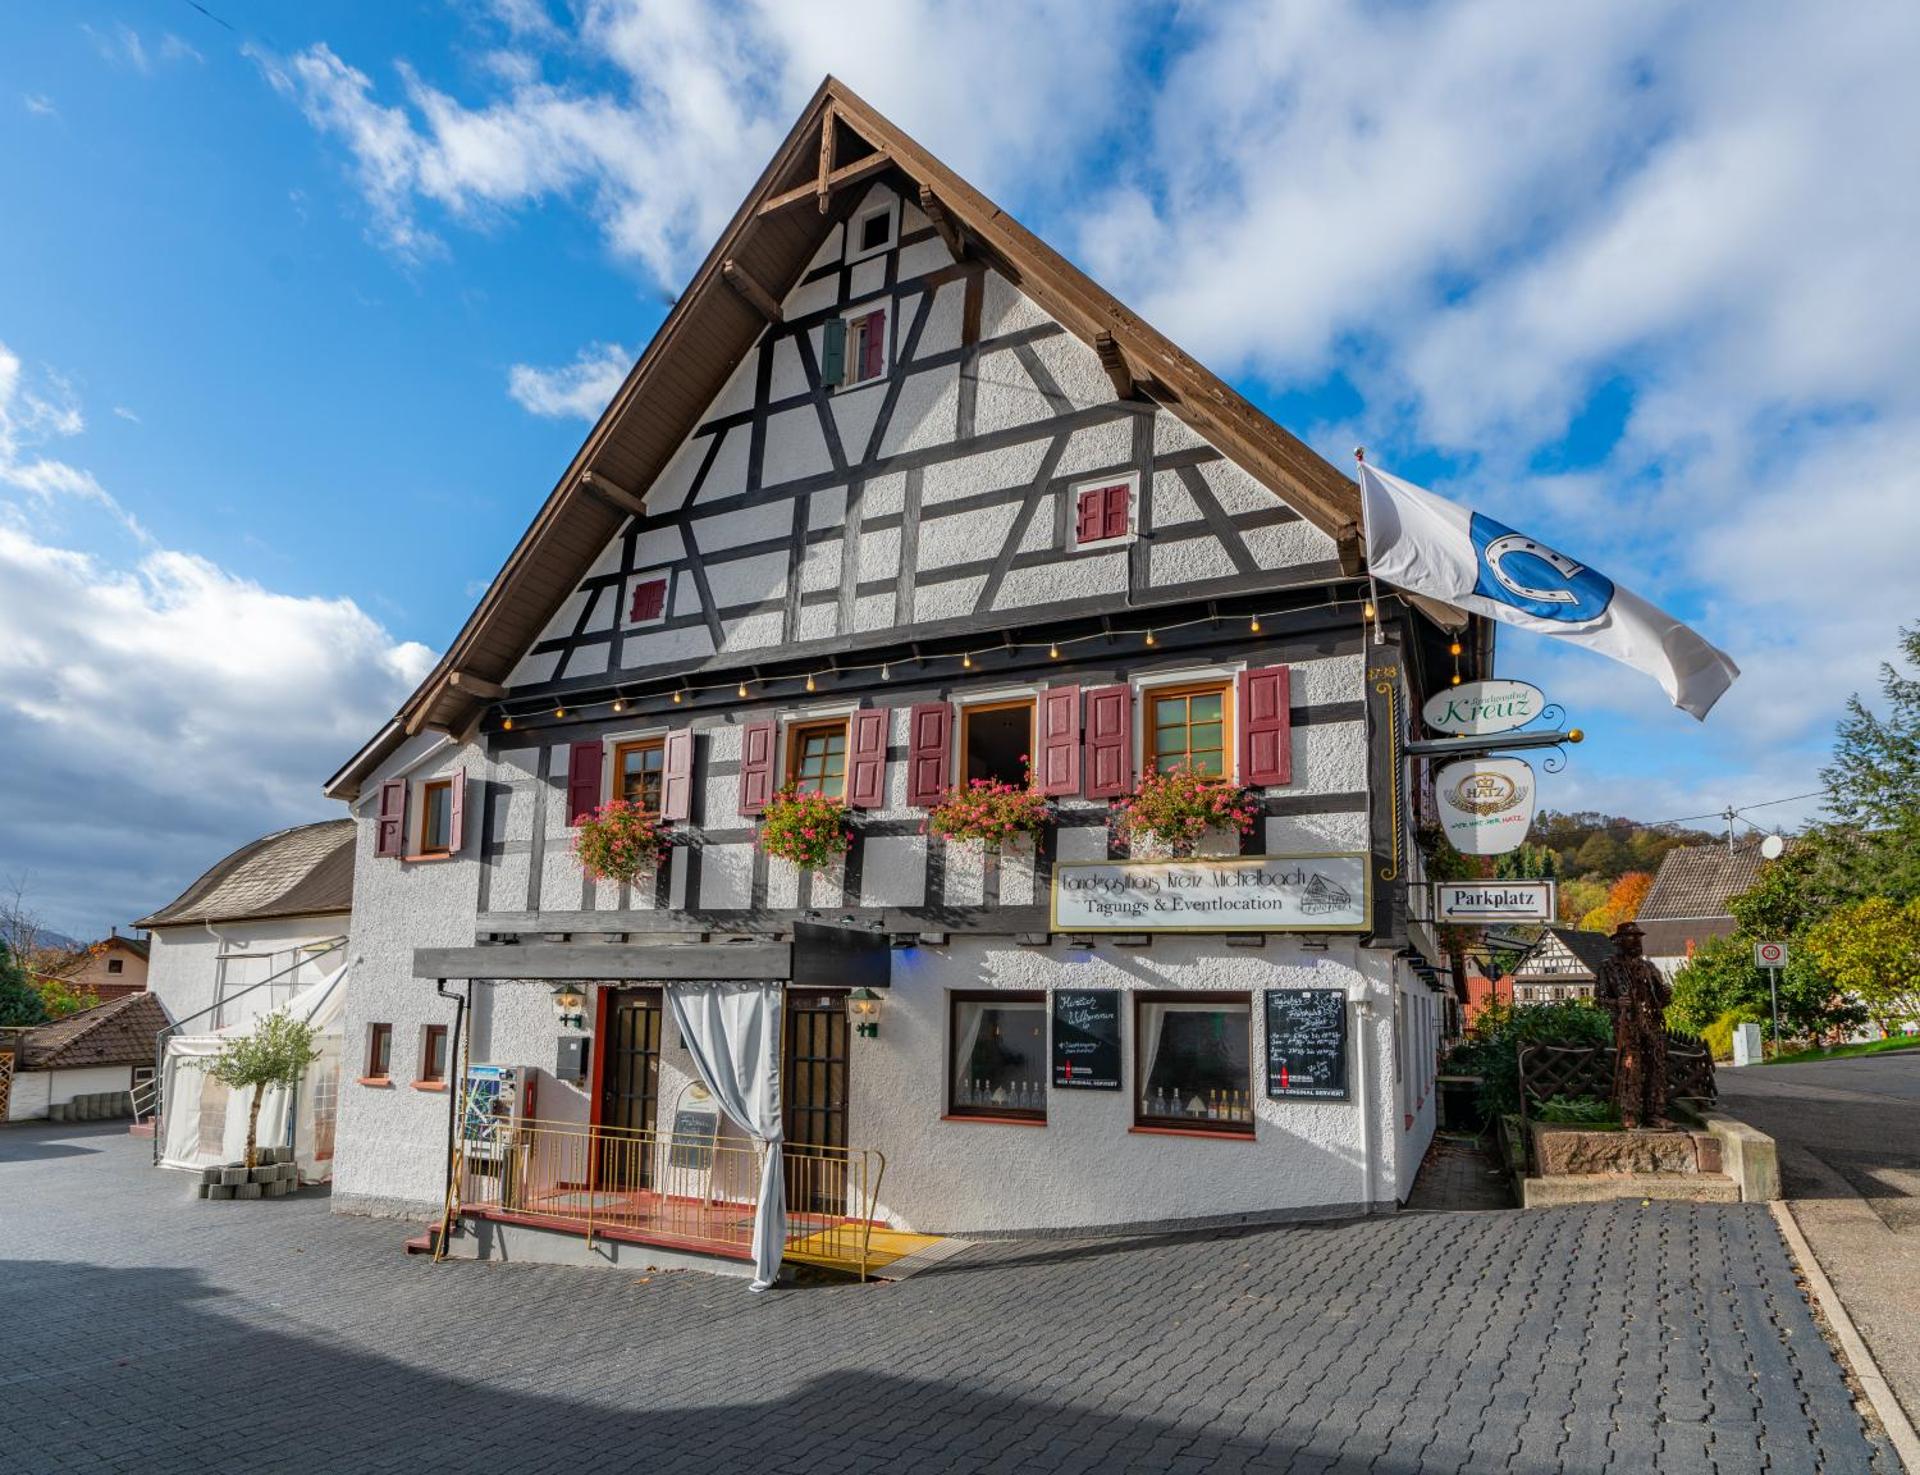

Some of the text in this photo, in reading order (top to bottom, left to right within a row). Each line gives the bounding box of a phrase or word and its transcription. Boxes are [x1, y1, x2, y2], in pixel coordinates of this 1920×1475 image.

[1434, 698, 1530, 725] Kreuz
[1466, 786, 1505, 798] HATZ
[1212, 867, 1305, 889] Michelbach
[1085, 895, 1283, 917] Tagungs & Eventlocation
[1454, 890, 1535, 911] Parkplatz
